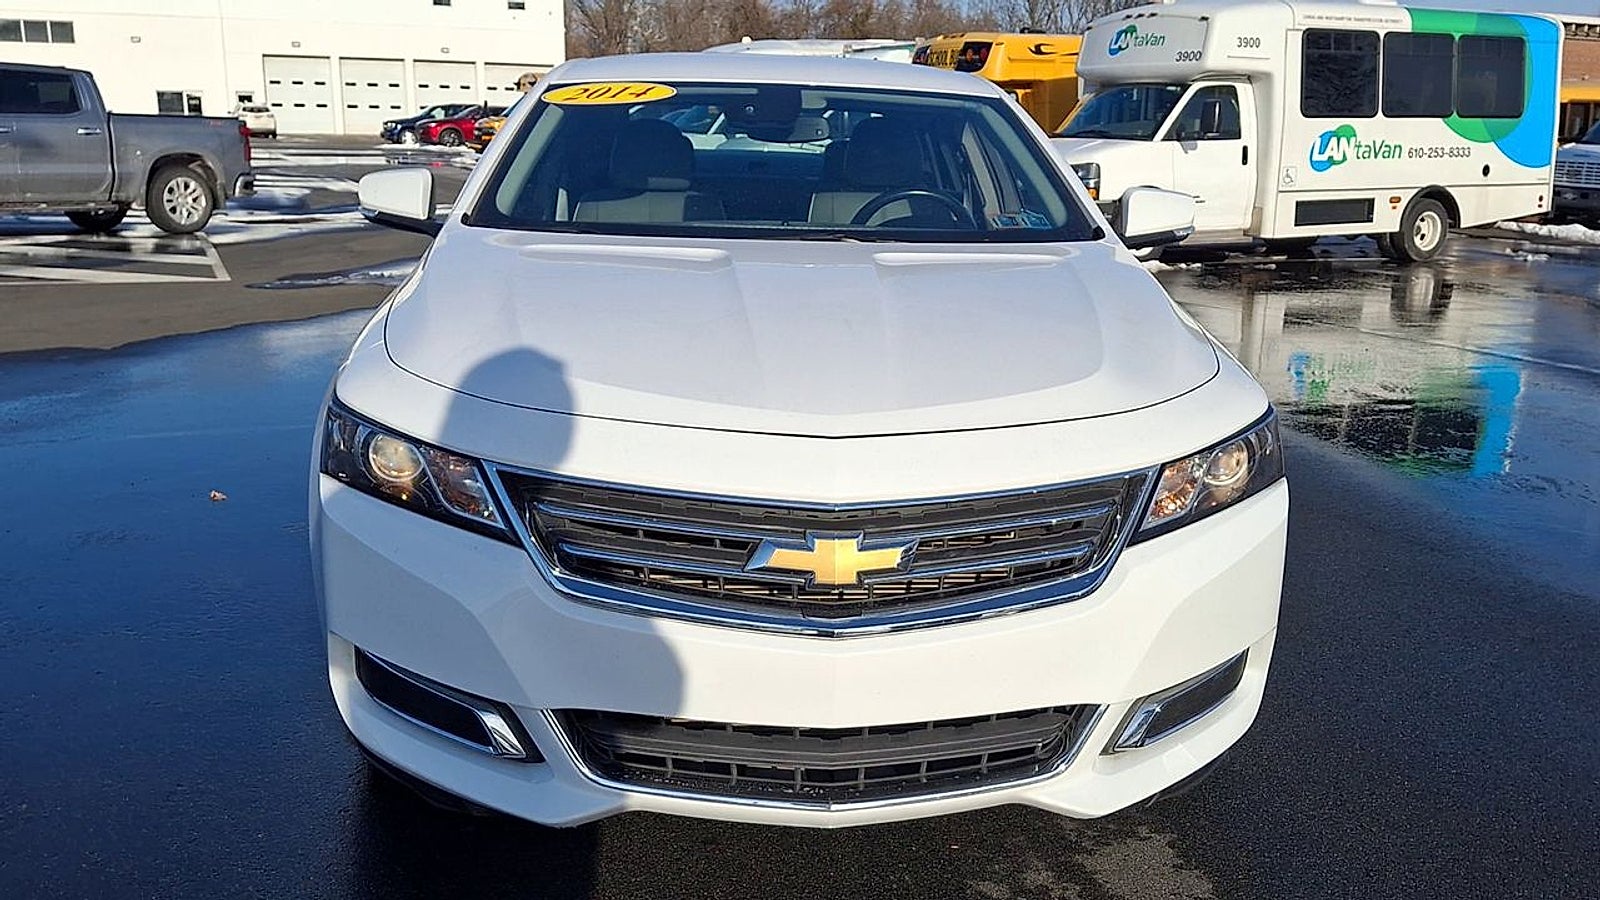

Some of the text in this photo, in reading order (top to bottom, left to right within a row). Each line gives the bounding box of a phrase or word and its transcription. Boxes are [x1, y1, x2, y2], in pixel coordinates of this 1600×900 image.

[1237, 37, 1261, 48] 3900
[1175, 51, 1202, 62] 3900
[561, 86, 656, 101] 2014
[1311, 136, 1471, 161] LANtaVan 610-253-8333
